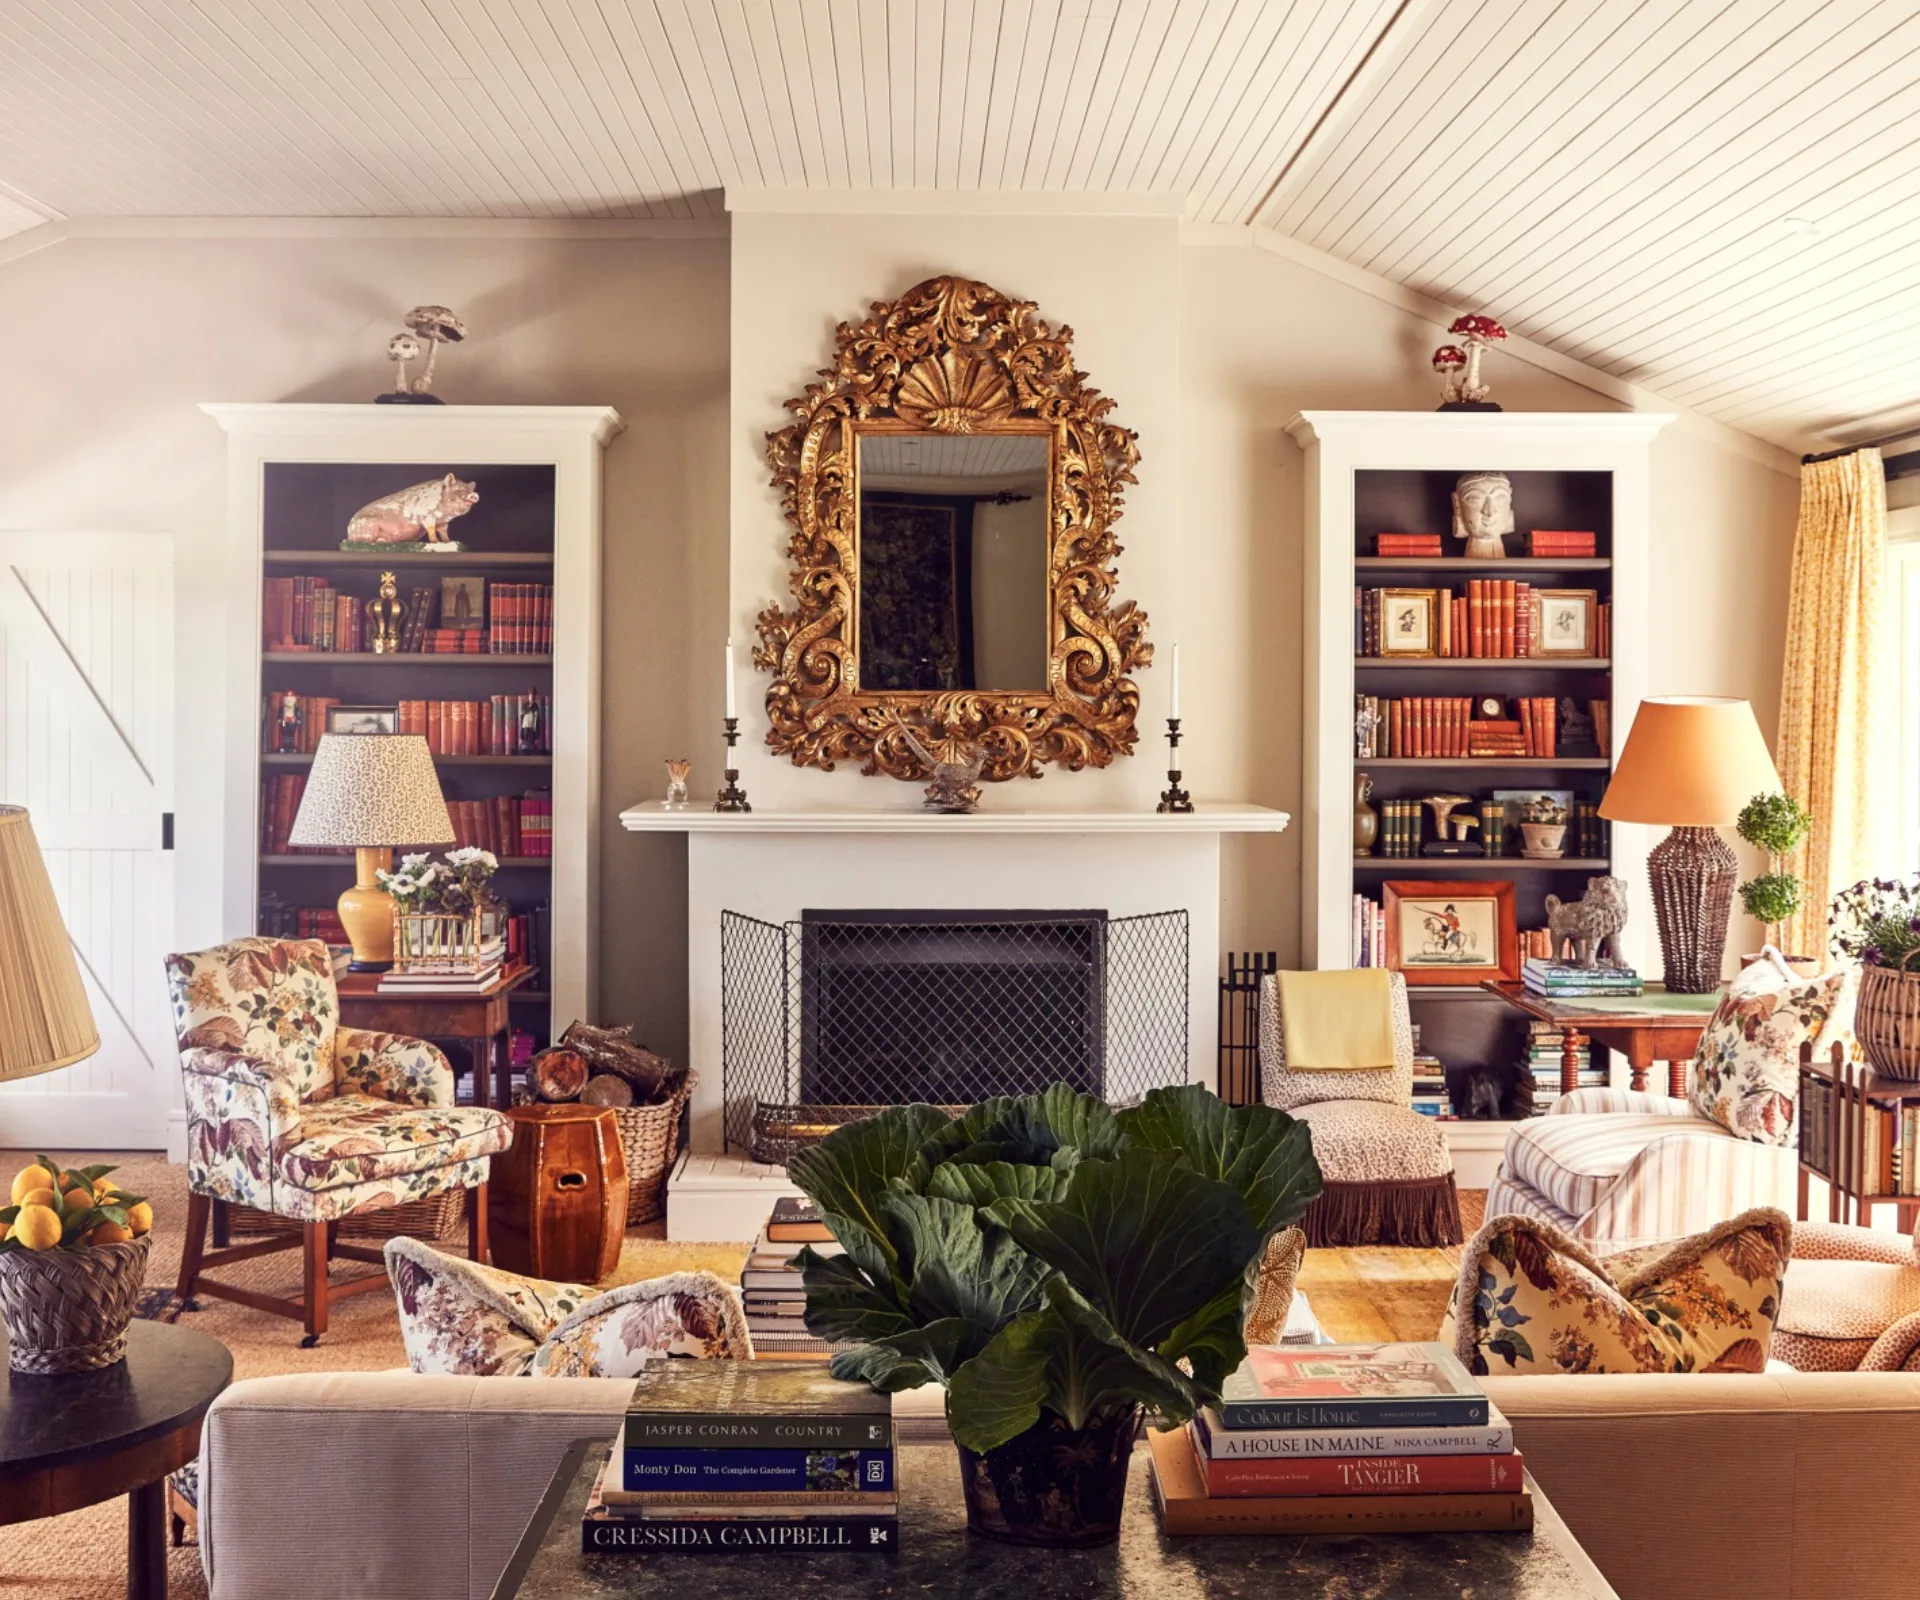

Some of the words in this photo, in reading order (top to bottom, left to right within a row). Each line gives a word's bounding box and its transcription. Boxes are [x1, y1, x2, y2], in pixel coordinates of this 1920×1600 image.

[1237, 1407, 1292, 1424] Colour
[1312, 1407, 1360, 1423] Home
[645, 1425, 693, 1436] JASPER
[699, 1425, 759, 1436] CONRAN
[775, 1425, 842, 1436] COUNTRY
[1226, 1440, 1237, 1453] A
[1242, 1438, 1300, 1453] HOUSE
[1305, 1437, 1324, 1451] IN
[1328, 1436, 1385, 1451] MAINE
[1394, 1437, 1423, 1447] NINA
[1424, 1436, 1478, 1446] CAMPBELL
[634, 1463, 670, 1475] Monty
[674, 1464, 697, 1474] Don
[703, 1466, 719, 1474] The
[721, 1465, 758, 1475] Complete
[760, 1466, 796, 1475] Gardener
[1357, 1459, 1401, 1469] INSIDE
[1337, 1463, 1421, 1485] TANGIER
[594, 1527, 713, 1545] CRESSIDA
[720, 1526, 851, 1545] CAMPBELL
